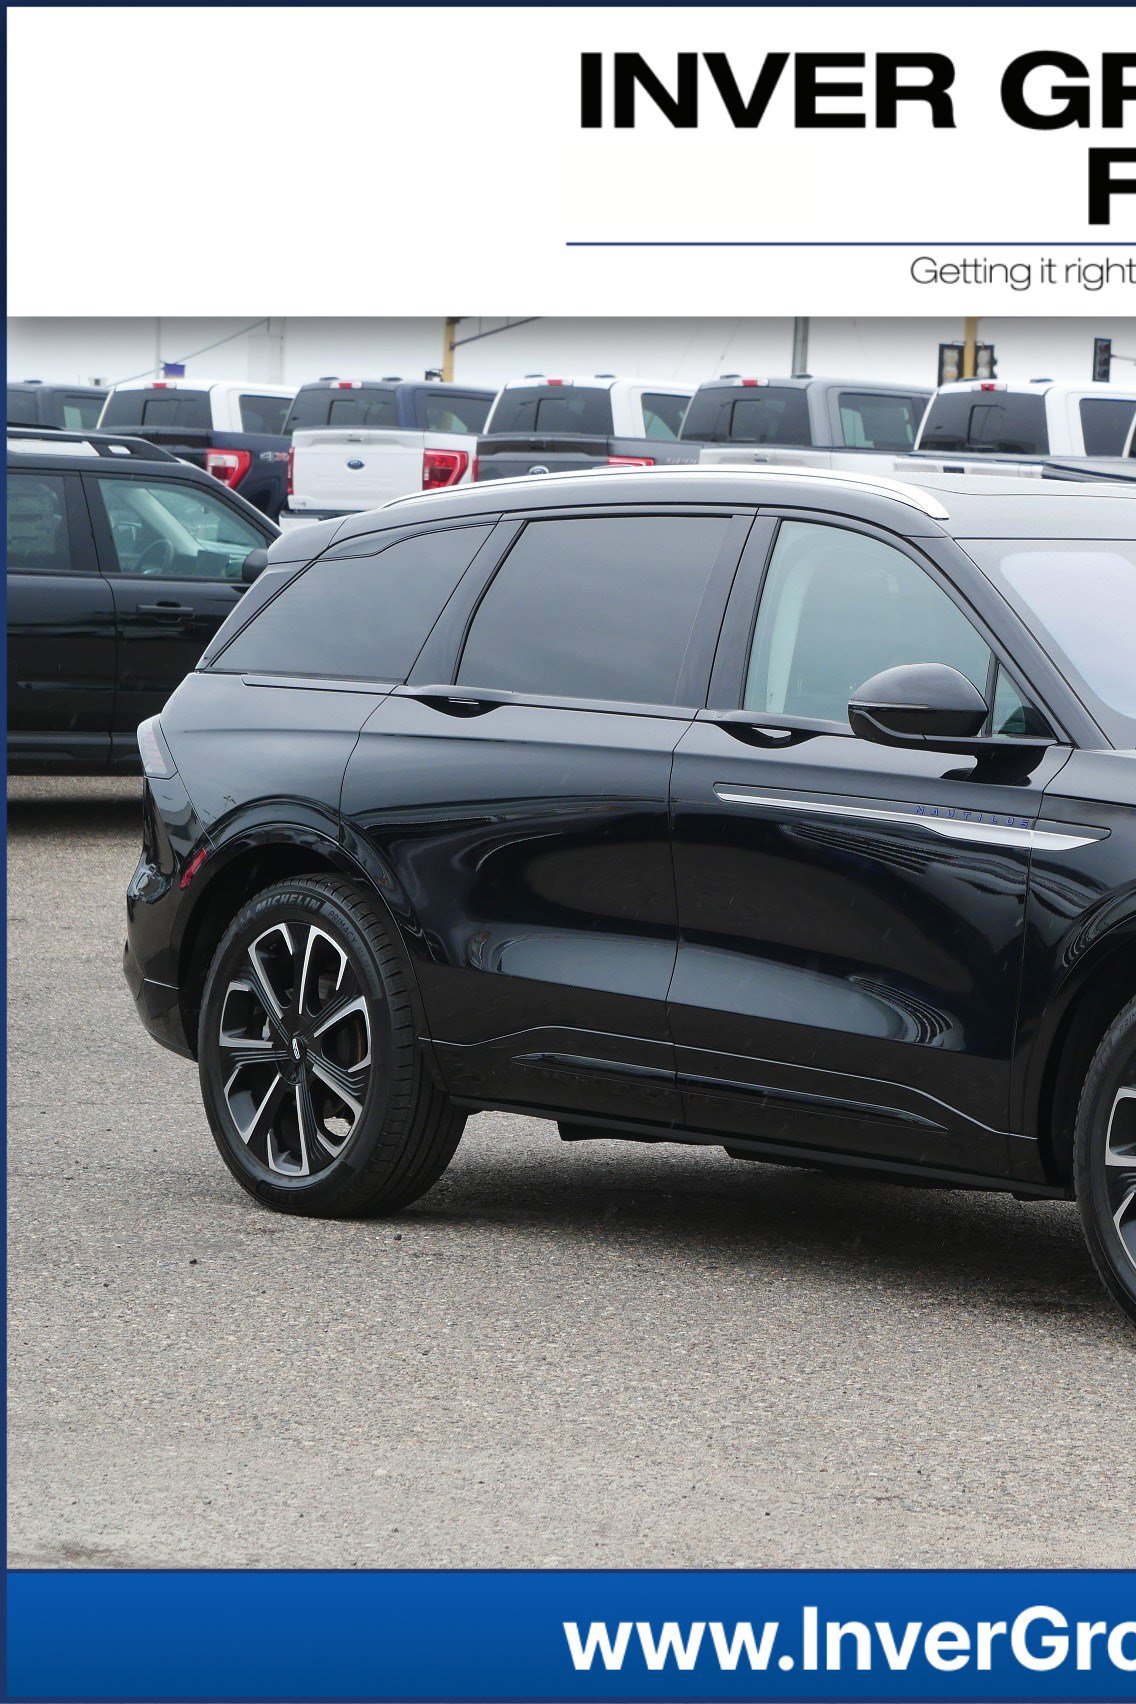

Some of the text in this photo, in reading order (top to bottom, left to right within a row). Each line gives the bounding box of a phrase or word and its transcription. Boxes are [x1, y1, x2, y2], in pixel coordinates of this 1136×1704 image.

[916, 805, 1030, 828] NAUTILUS
[255, 894, 321, 914] MICHELIN
[328, 910, 358, 943] PRIMACY
